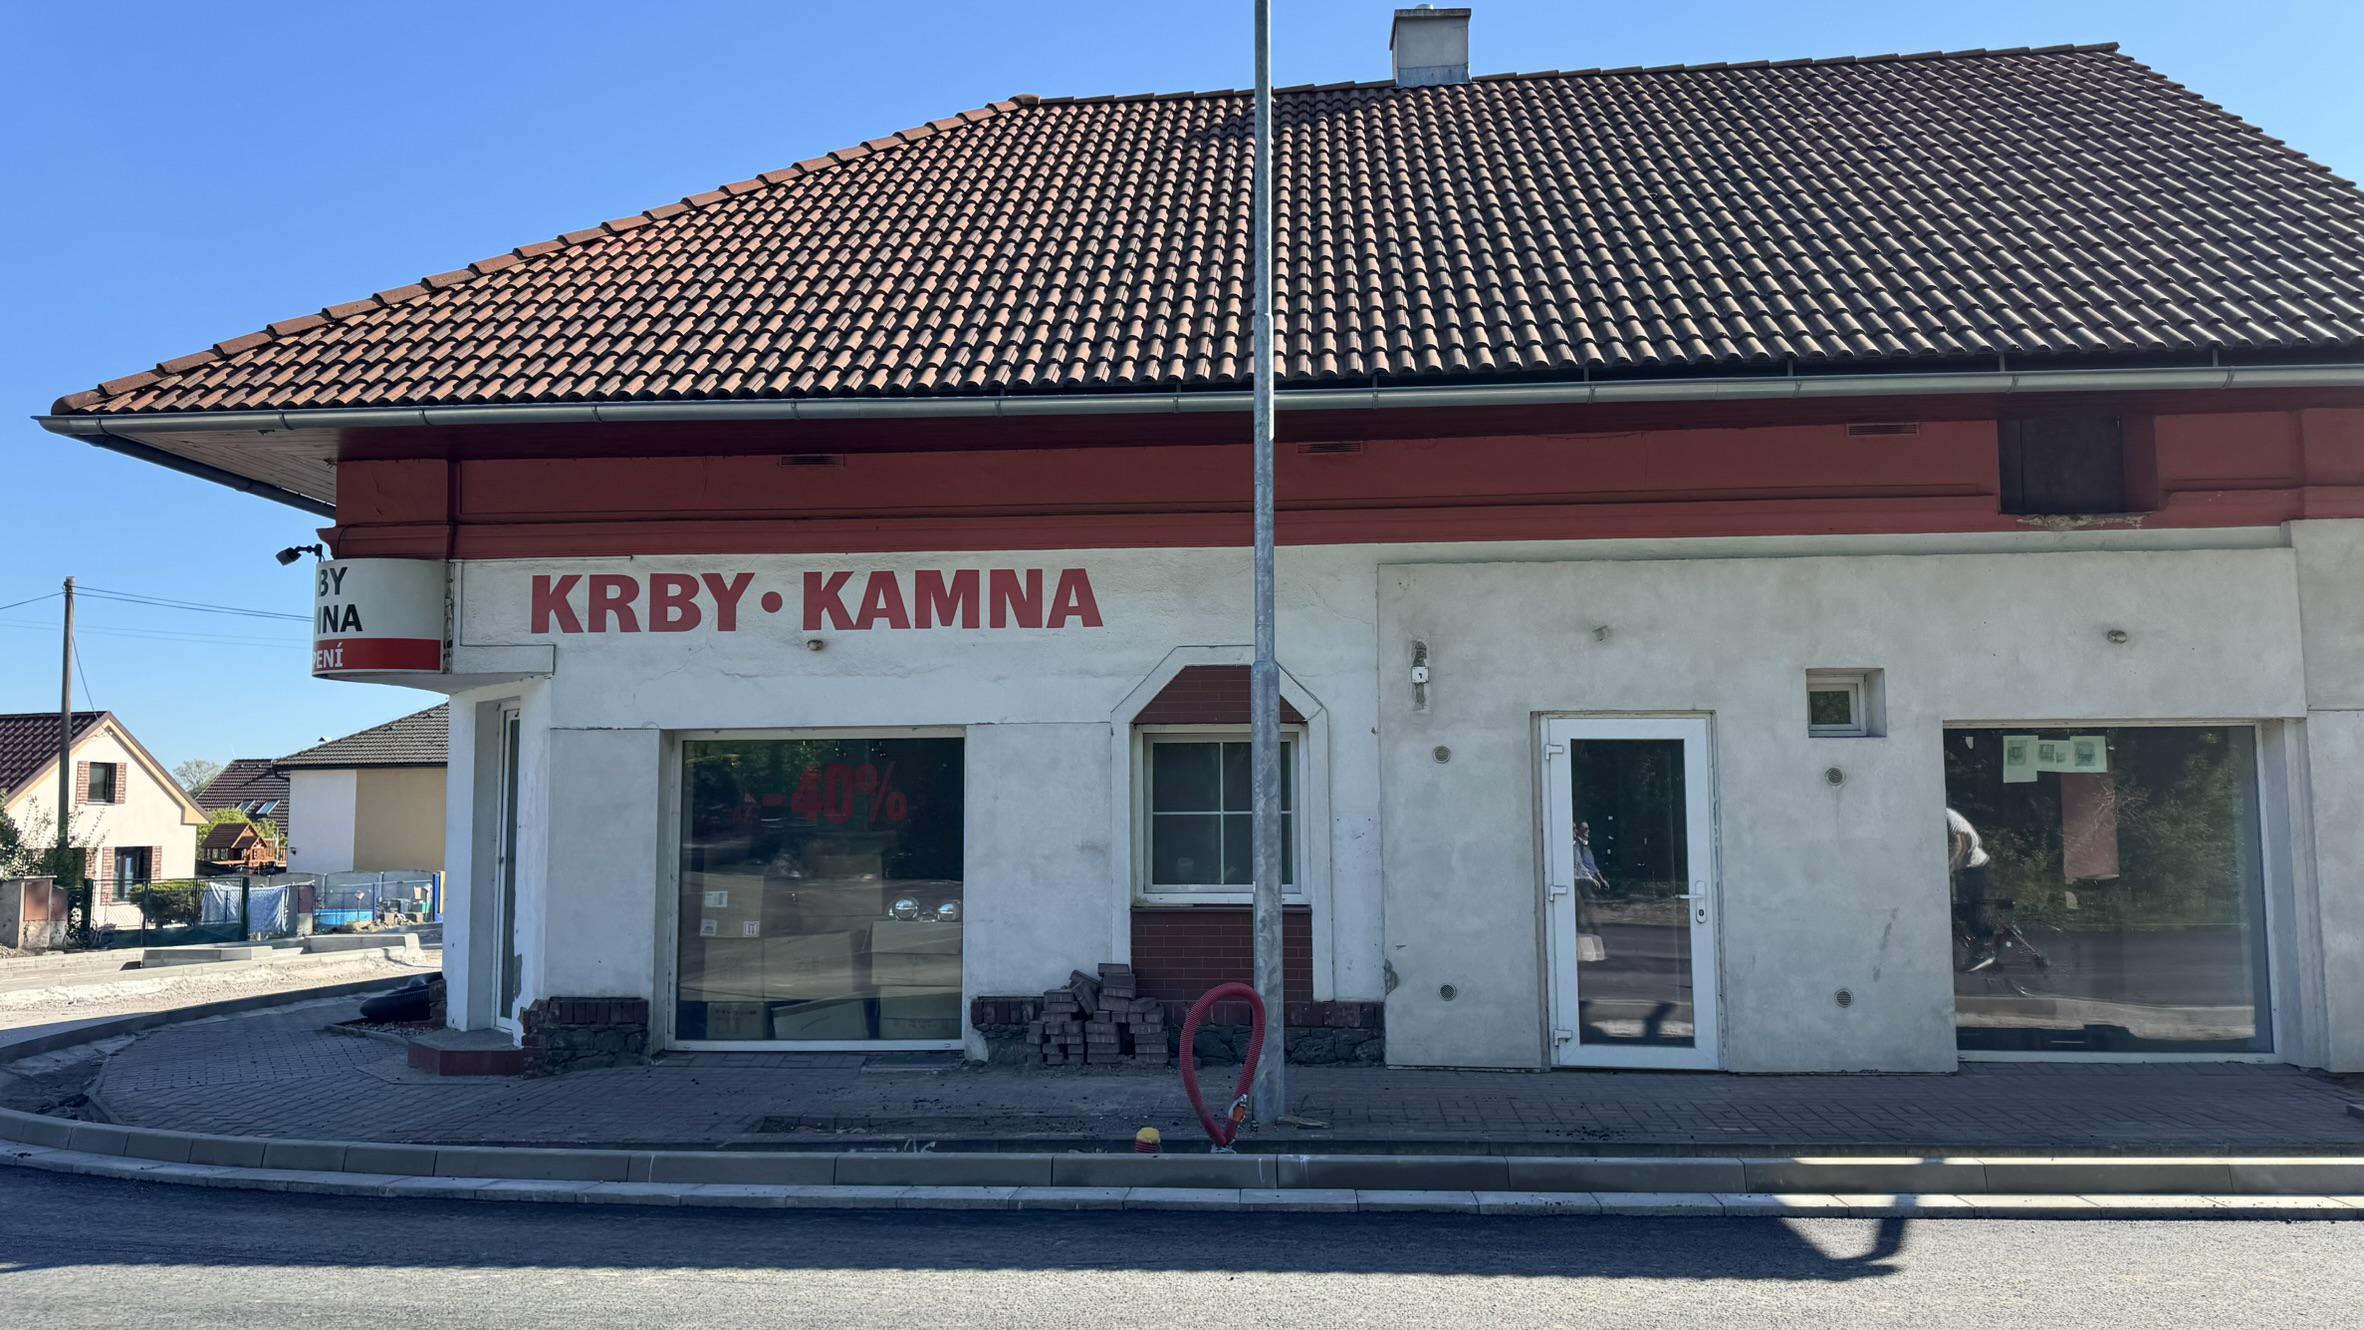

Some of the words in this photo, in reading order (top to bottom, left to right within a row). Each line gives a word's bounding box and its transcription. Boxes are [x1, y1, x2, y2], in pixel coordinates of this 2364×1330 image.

[317, 603, 364, 634] NA
[530, 572, 755, 634] KRBY
[802, 568, 1104, 631] KAMNA
[762, 760, 908, 824] -40%
